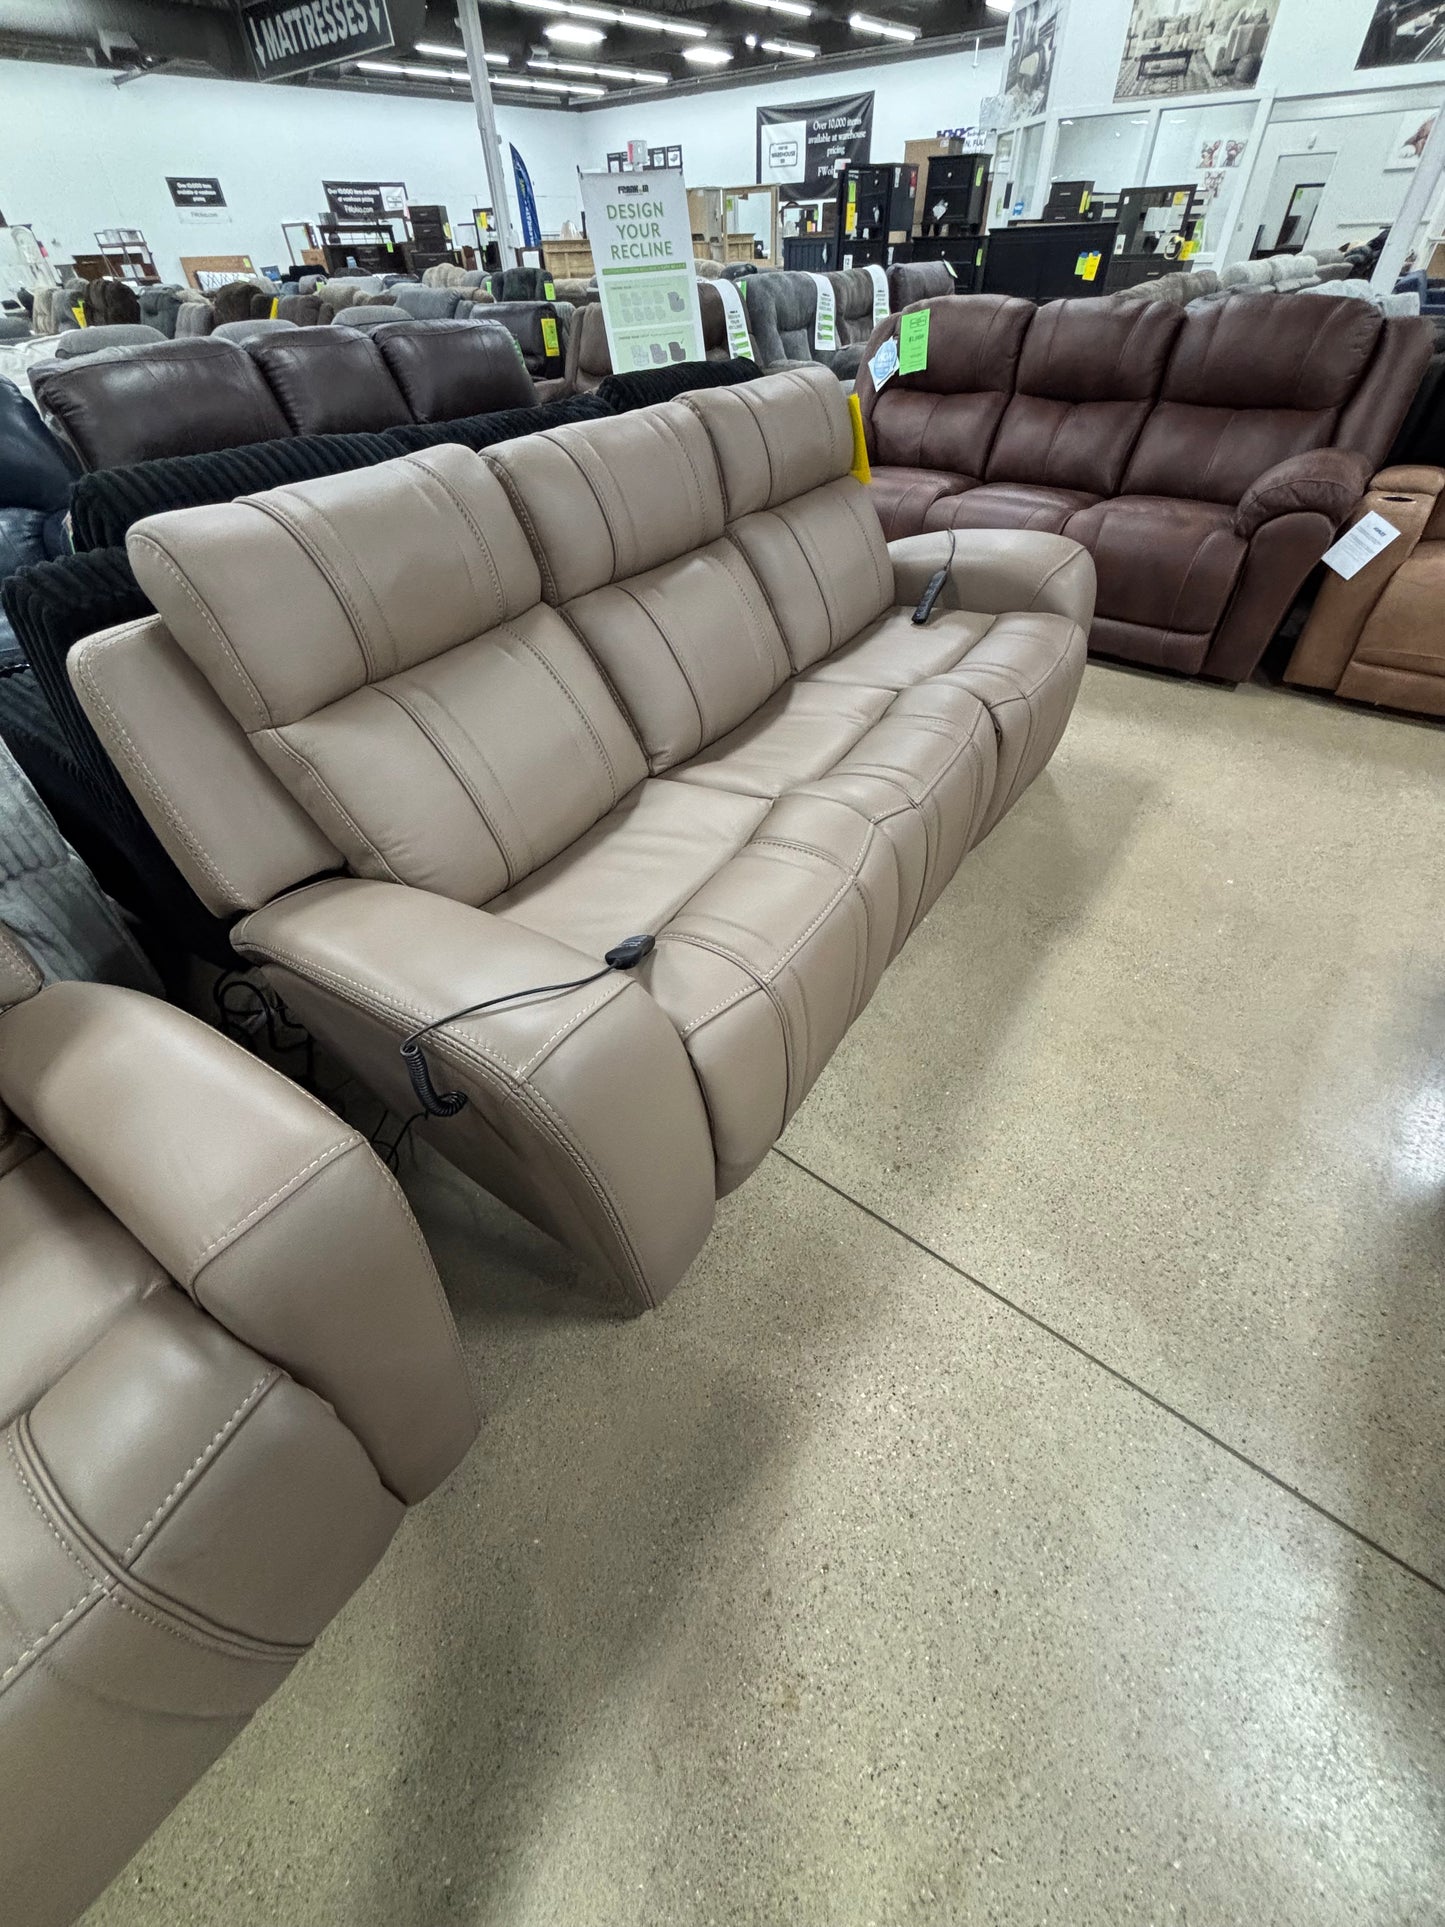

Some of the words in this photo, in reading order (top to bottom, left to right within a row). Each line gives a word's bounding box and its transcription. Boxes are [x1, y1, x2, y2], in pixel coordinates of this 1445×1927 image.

[260, 0, 368, 61] MATTRESSES
[813, 120, 827, 131] Over
[838, 129, 867, 141] warehouse
[826, 145, 845, 157] pricing
[606, 201, 664, 220] DESIGN
[616, 222, 661, 240] YOUR
[610, 240, 674, 261] RECLINE
